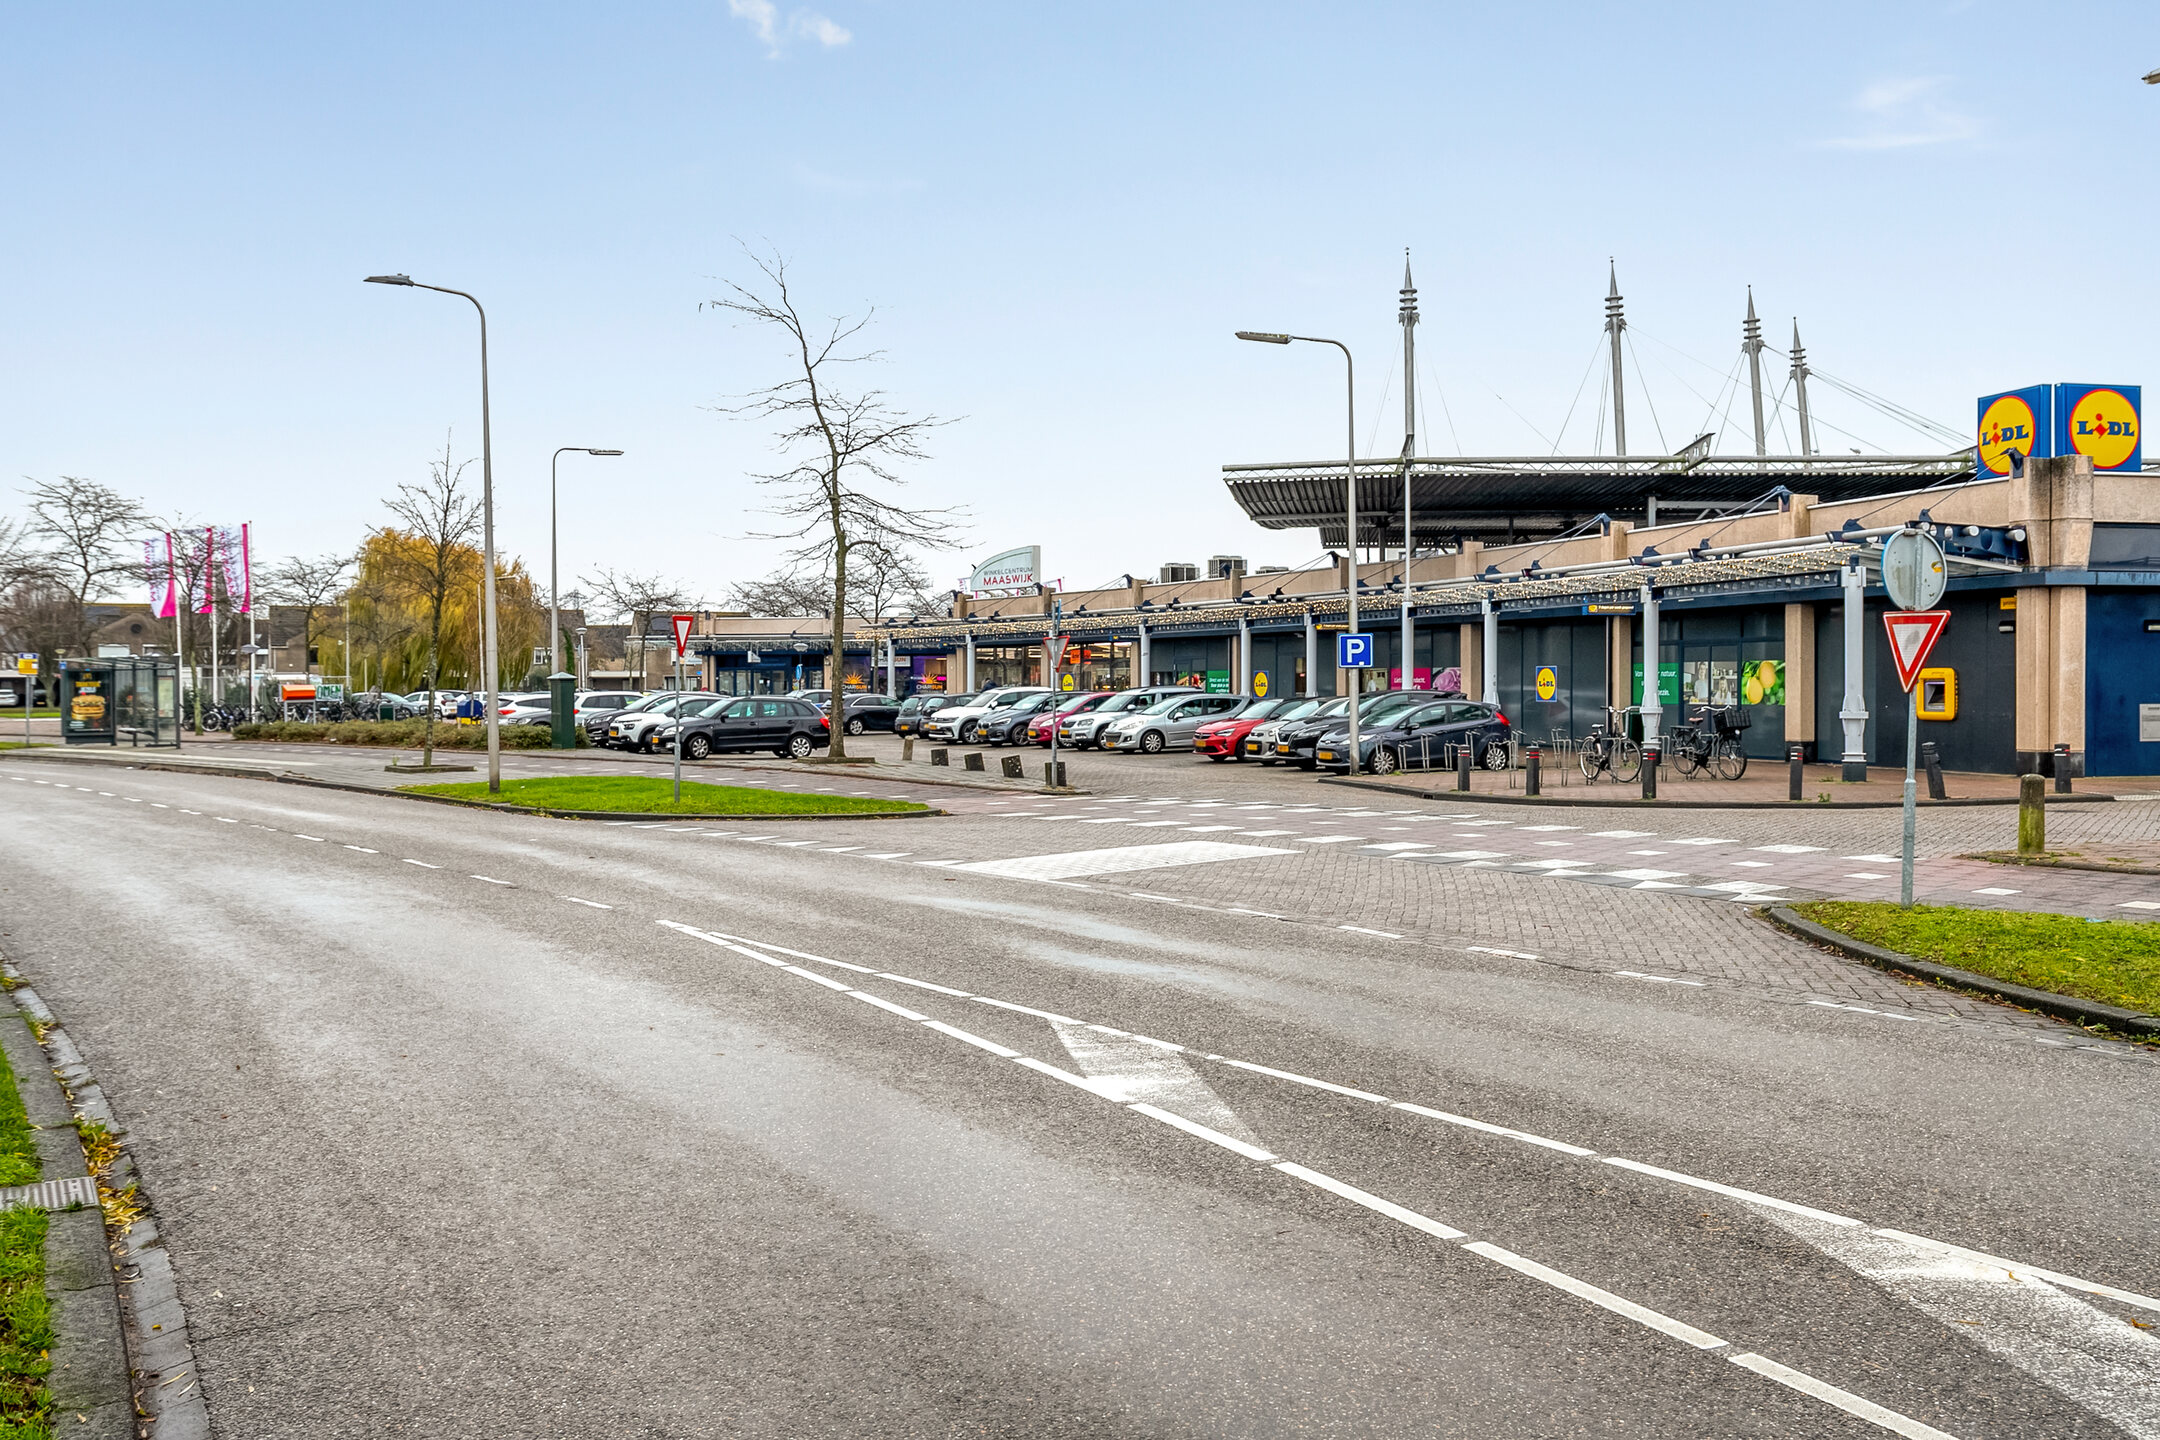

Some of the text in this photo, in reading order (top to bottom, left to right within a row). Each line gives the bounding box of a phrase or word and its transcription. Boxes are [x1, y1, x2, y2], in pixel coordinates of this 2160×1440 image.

[983, 566, 1033, 576] WINKELCENTRUM
[983, 573, 1033, 586] MAASWIJK
[1347, 639, 1364, 663] P
